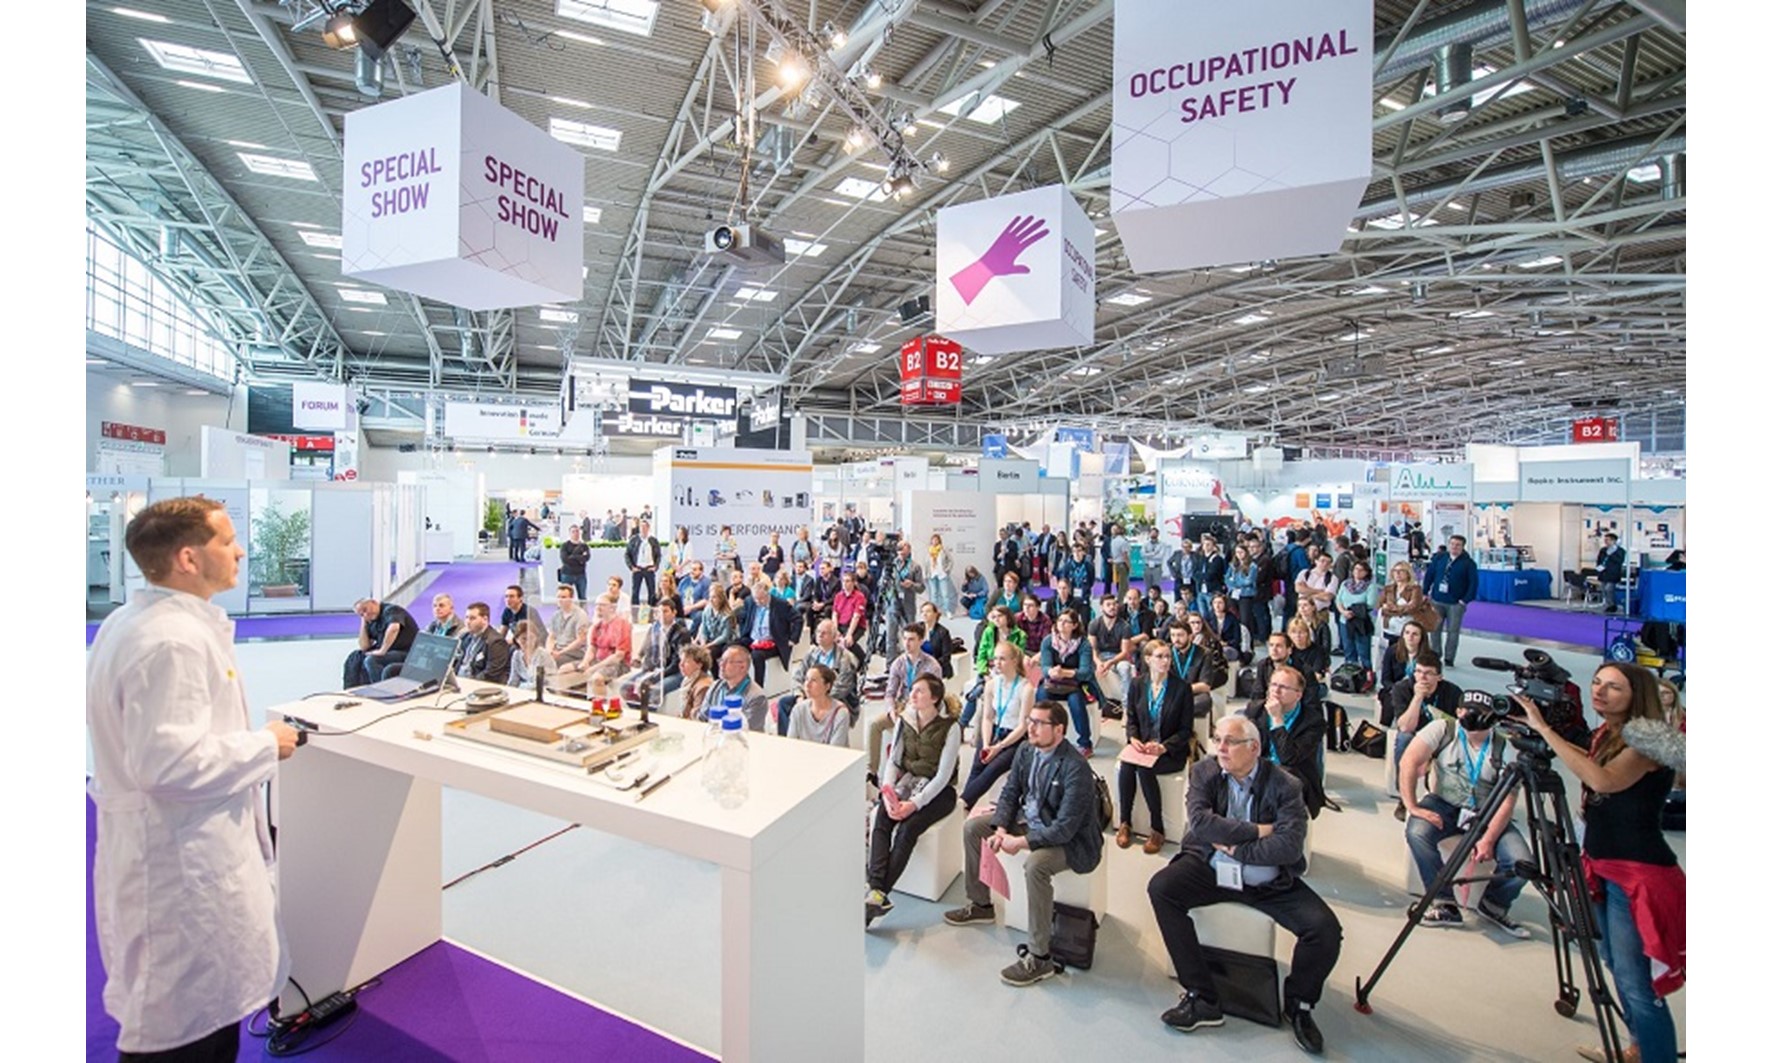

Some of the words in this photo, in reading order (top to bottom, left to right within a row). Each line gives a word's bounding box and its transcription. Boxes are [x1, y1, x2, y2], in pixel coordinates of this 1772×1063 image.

[1130, 29, 1358, 99] OCCUPATIONAL
[1180, 77, 1297, 124] SAFETY
[360, 147, 442, 188] SPECIAL
[484, 154, 570, 219] SPECIAL
[371, 182, 430, 219] SHOW
[497, 194, 559, 243] SHOW
[907, 350, 921, 372] B2
[936, 351, 959, 371] B2
[301, 401, 339, 411] FORUM
[650, 385, 735, 415] Parker
[480, 409, 518, 418] Innovation
[529, 428, 560, 438] Germany
[618, 414, 682, 435] Parker
[1582, 425, 1602, 437] B2
[306, 440, 315, 449] A
[1557, 476, 1604, 484] Instrument
[1607, 476, 1624, 484] Inc.
[706, 523, 718, 536] IS
